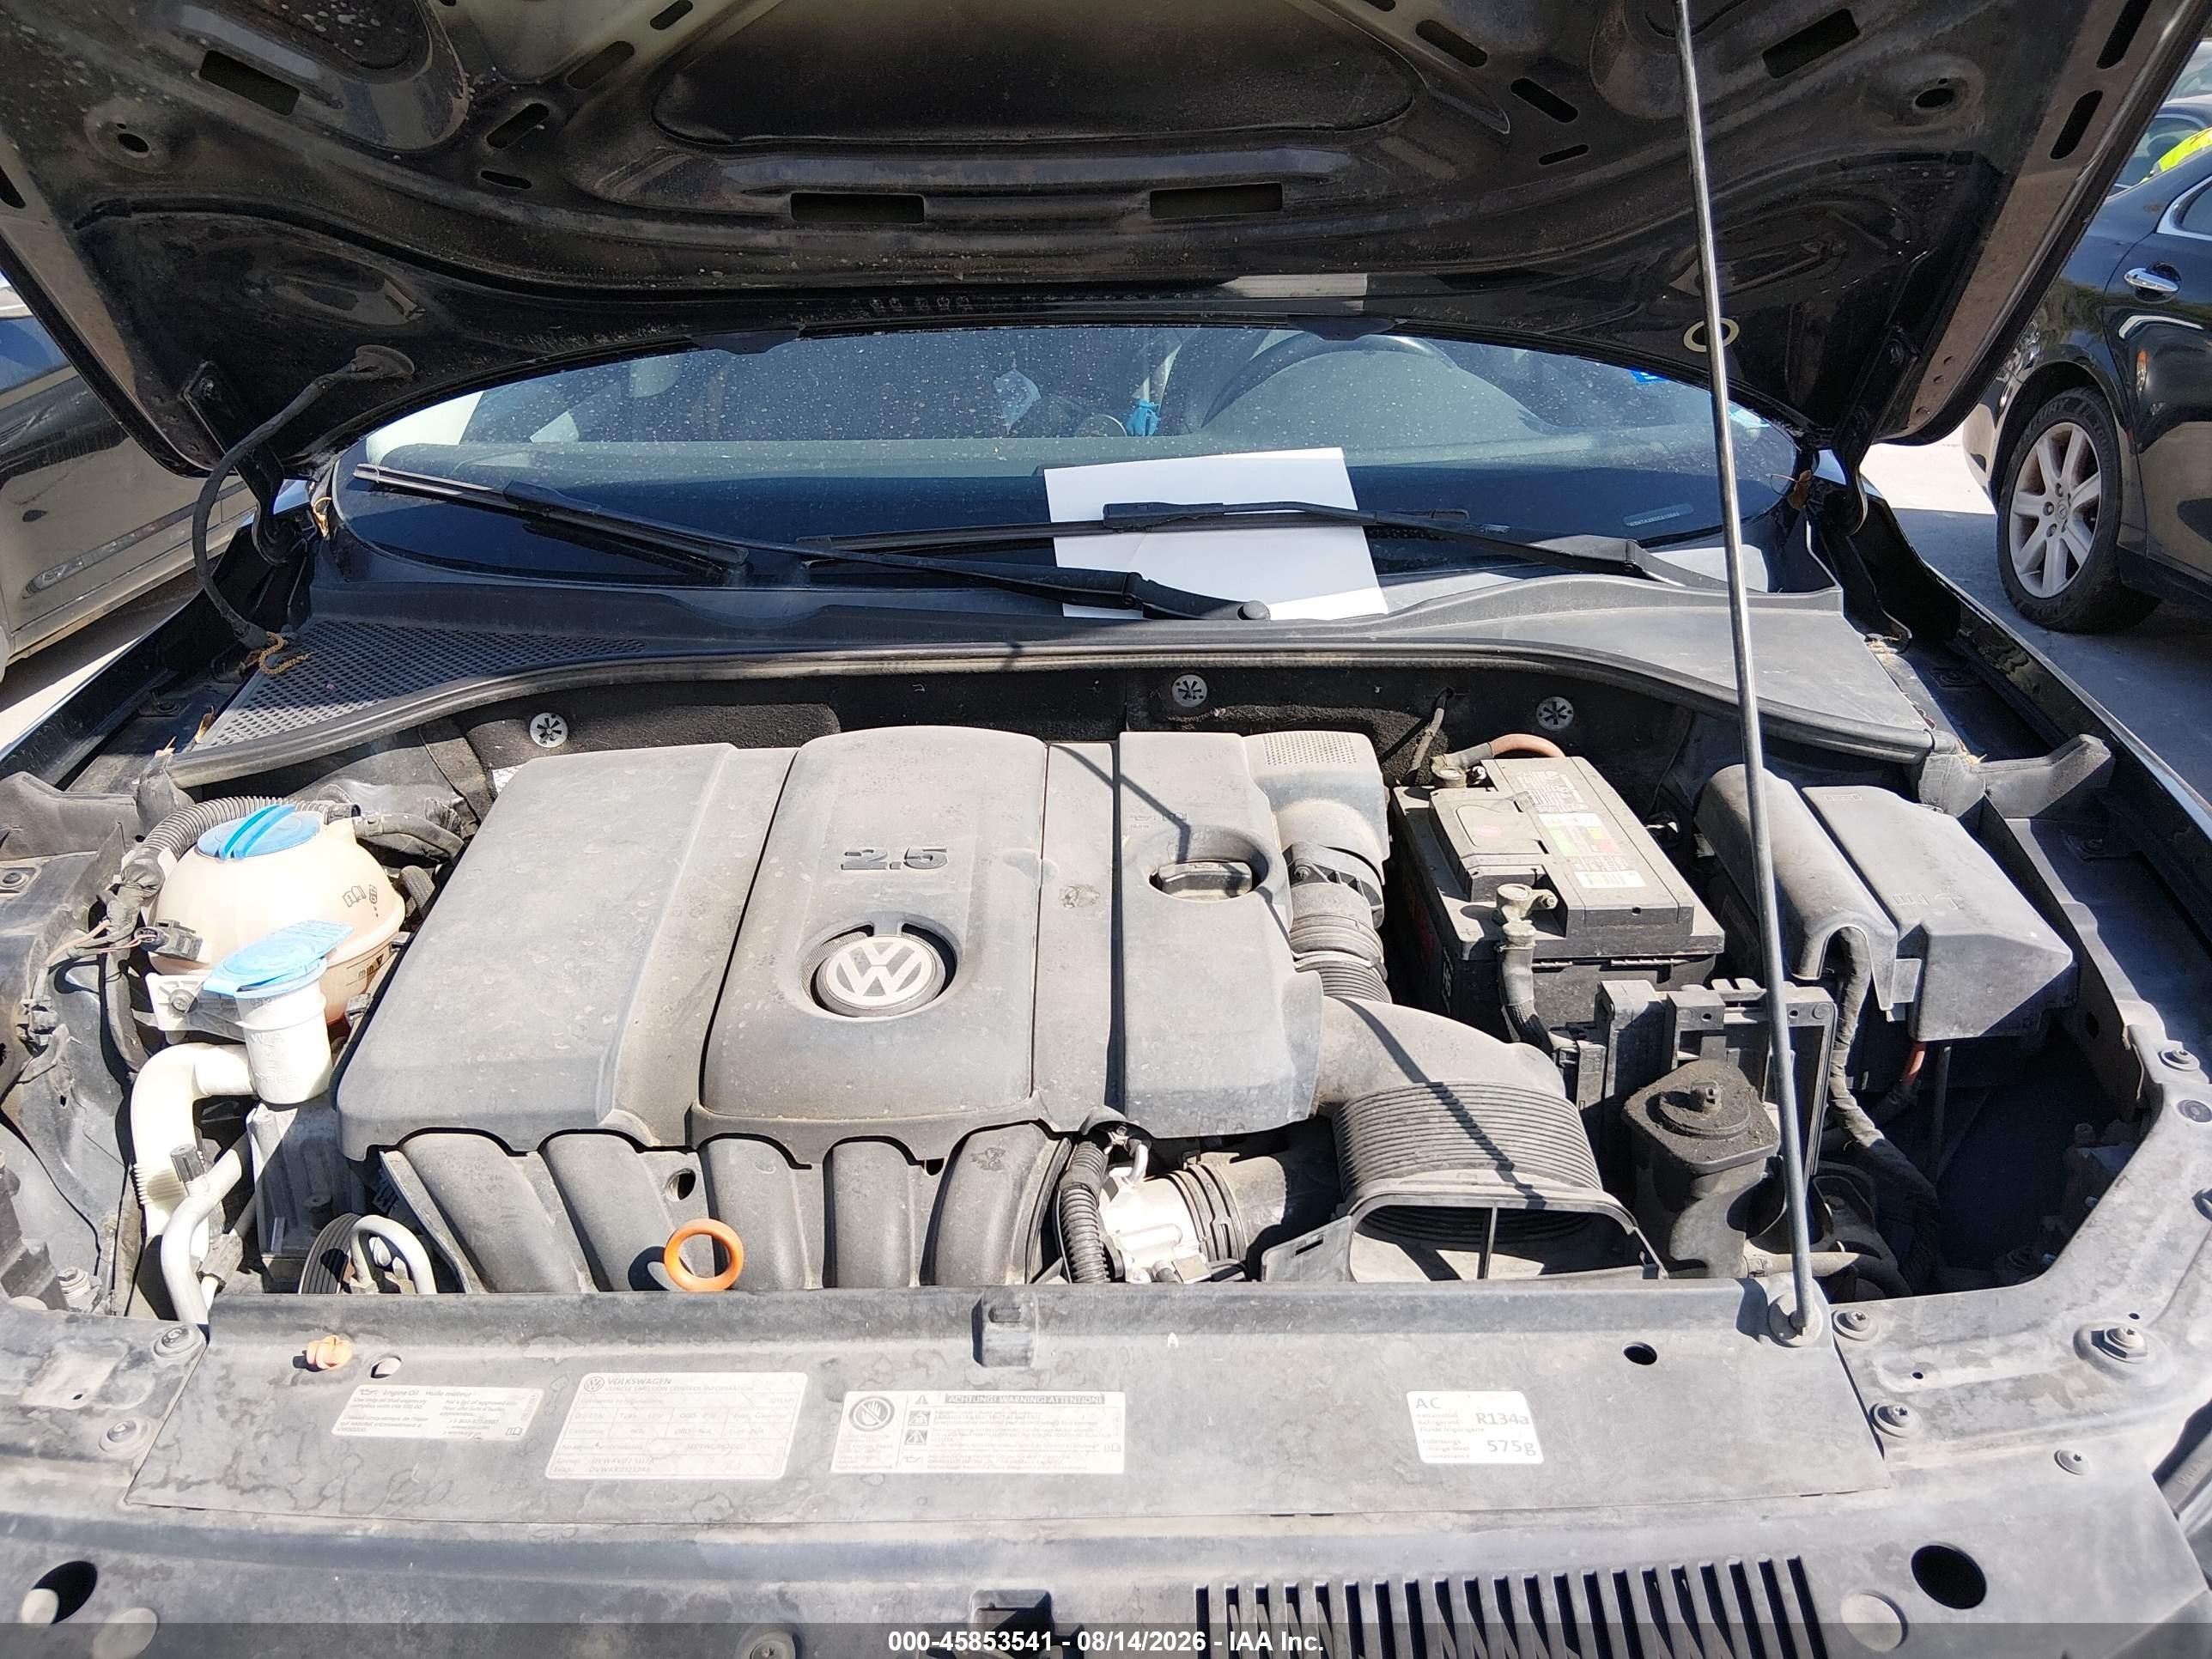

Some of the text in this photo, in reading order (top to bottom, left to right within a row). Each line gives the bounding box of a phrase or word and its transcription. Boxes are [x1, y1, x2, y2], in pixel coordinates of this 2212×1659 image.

[841, 847, 948, 871] 2.5
[358, 963, 374, 979] min
[383, 1389, 407, 1397] Engine
[998, 1395, 1046, 1404] WARNING!
[1047, 1395, 1103, 1404] ATTENTION!
[1415, 1397, 1443, 1409] AC
[1475, 1413, 1530, 1425] R134a
[1486, 1439, 1537, 1457] 575g
